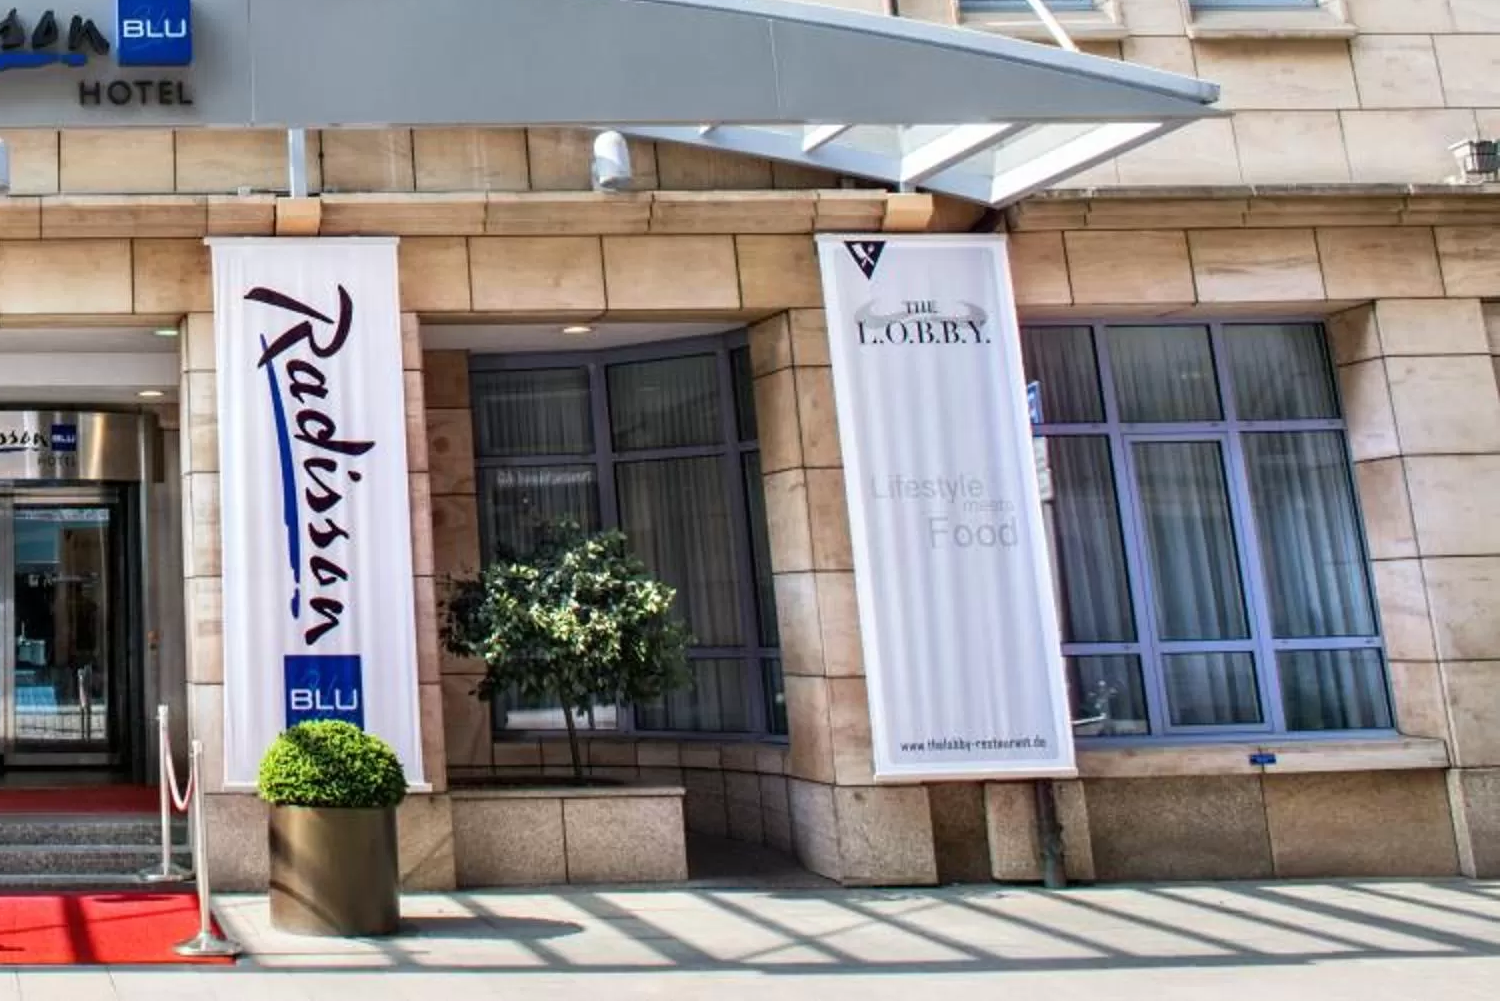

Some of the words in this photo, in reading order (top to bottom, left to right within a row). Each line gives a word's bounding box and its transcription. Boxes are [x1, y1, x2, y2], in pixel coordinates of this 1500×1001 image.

[122, 18, 187, 38] BLU
[78, 79, 193, 106] HOTEL
[901, 300, 939, 314] THE
[856, 320, 992, 344] L.O.B.B.Y.
[244, 284, 376, 646] Radisson
[870, 472, 985, 504] Lifestyle
[928, 516, 1019, 548] Food
[291, 688, 358, 710] BLU
